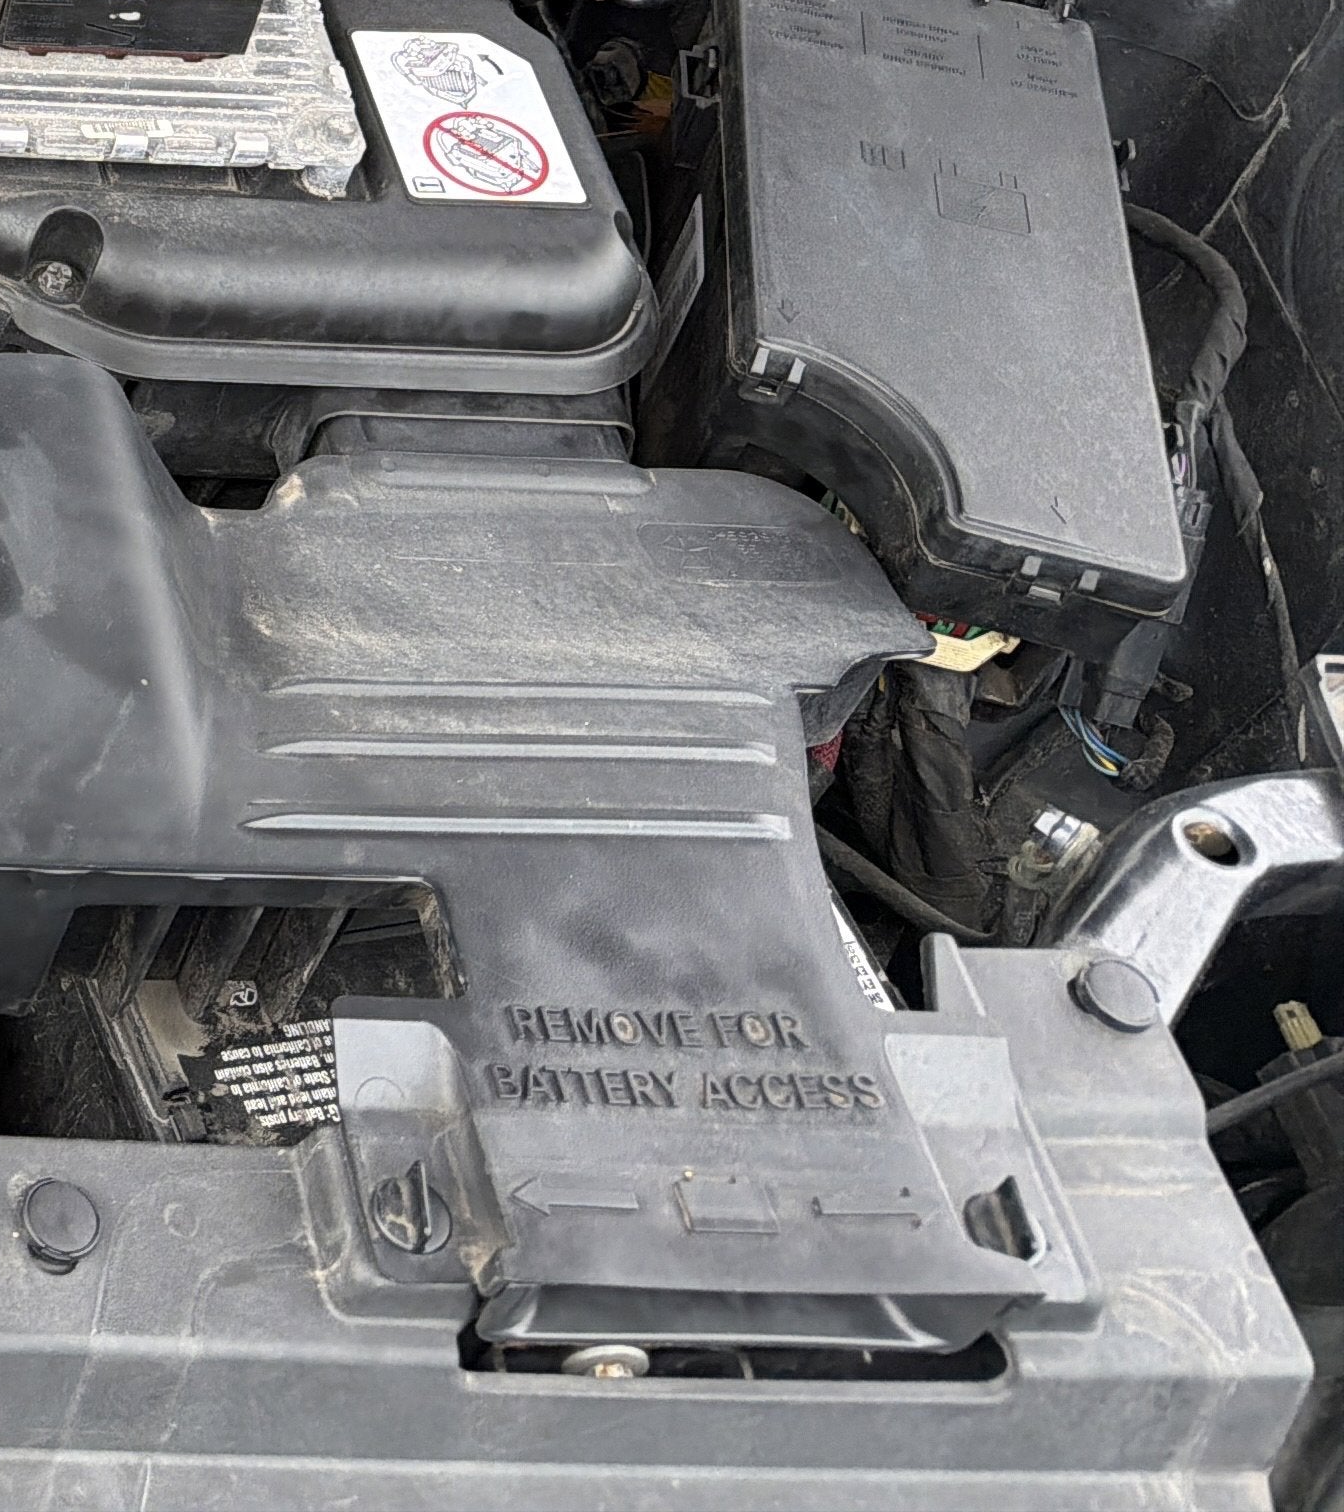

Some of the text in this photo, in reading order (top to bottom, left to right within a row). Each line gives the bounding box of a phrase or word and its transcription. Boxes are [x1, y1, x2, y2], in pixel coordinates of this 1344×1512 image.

[283, 1019, 330, 1036] ANDLING
[506, 1003, 811, 1050] REMOVE FOR
[250, 1045, 262, 1058] to
[263, 1039, 310, 1054] California
[220, 1047, 251, 1062] cause
[252, 1061, 274, 1076] also
[276, 1056, 320, 1071] Batteries
[303, 1071, 330, 1086] State
[229, 1084, 242, 1097] to
[488, 1062, 886, 1112] BATTERY ACCESS
[243, 1098, 269, 1114] lead
